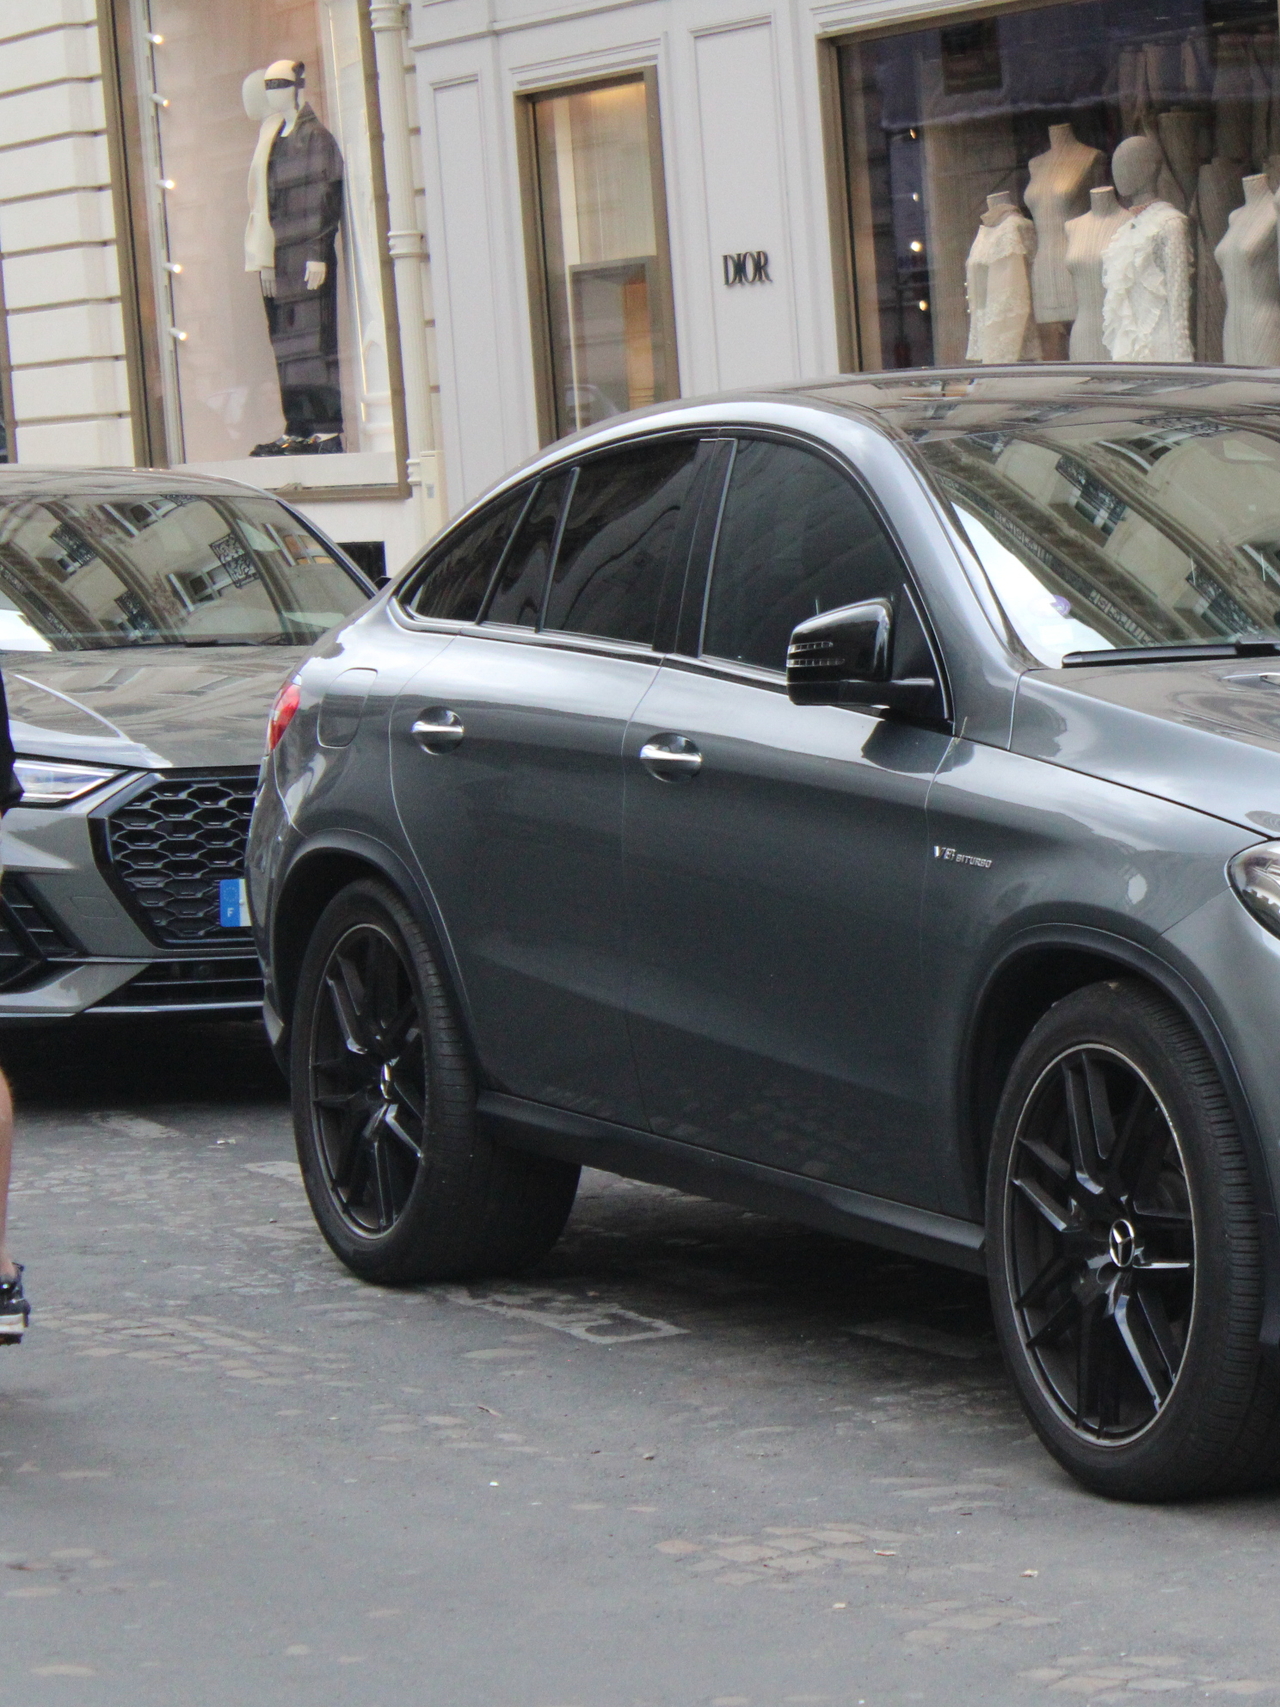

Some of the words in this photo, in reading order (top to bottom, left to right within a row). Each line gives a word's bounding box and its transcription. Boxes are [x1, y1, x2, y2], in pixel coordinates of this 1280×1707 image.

[722, 250, 773, 286] DIOR
[955, 853, 993, 869] BITURBO
[227, 907, 235, 918] F
